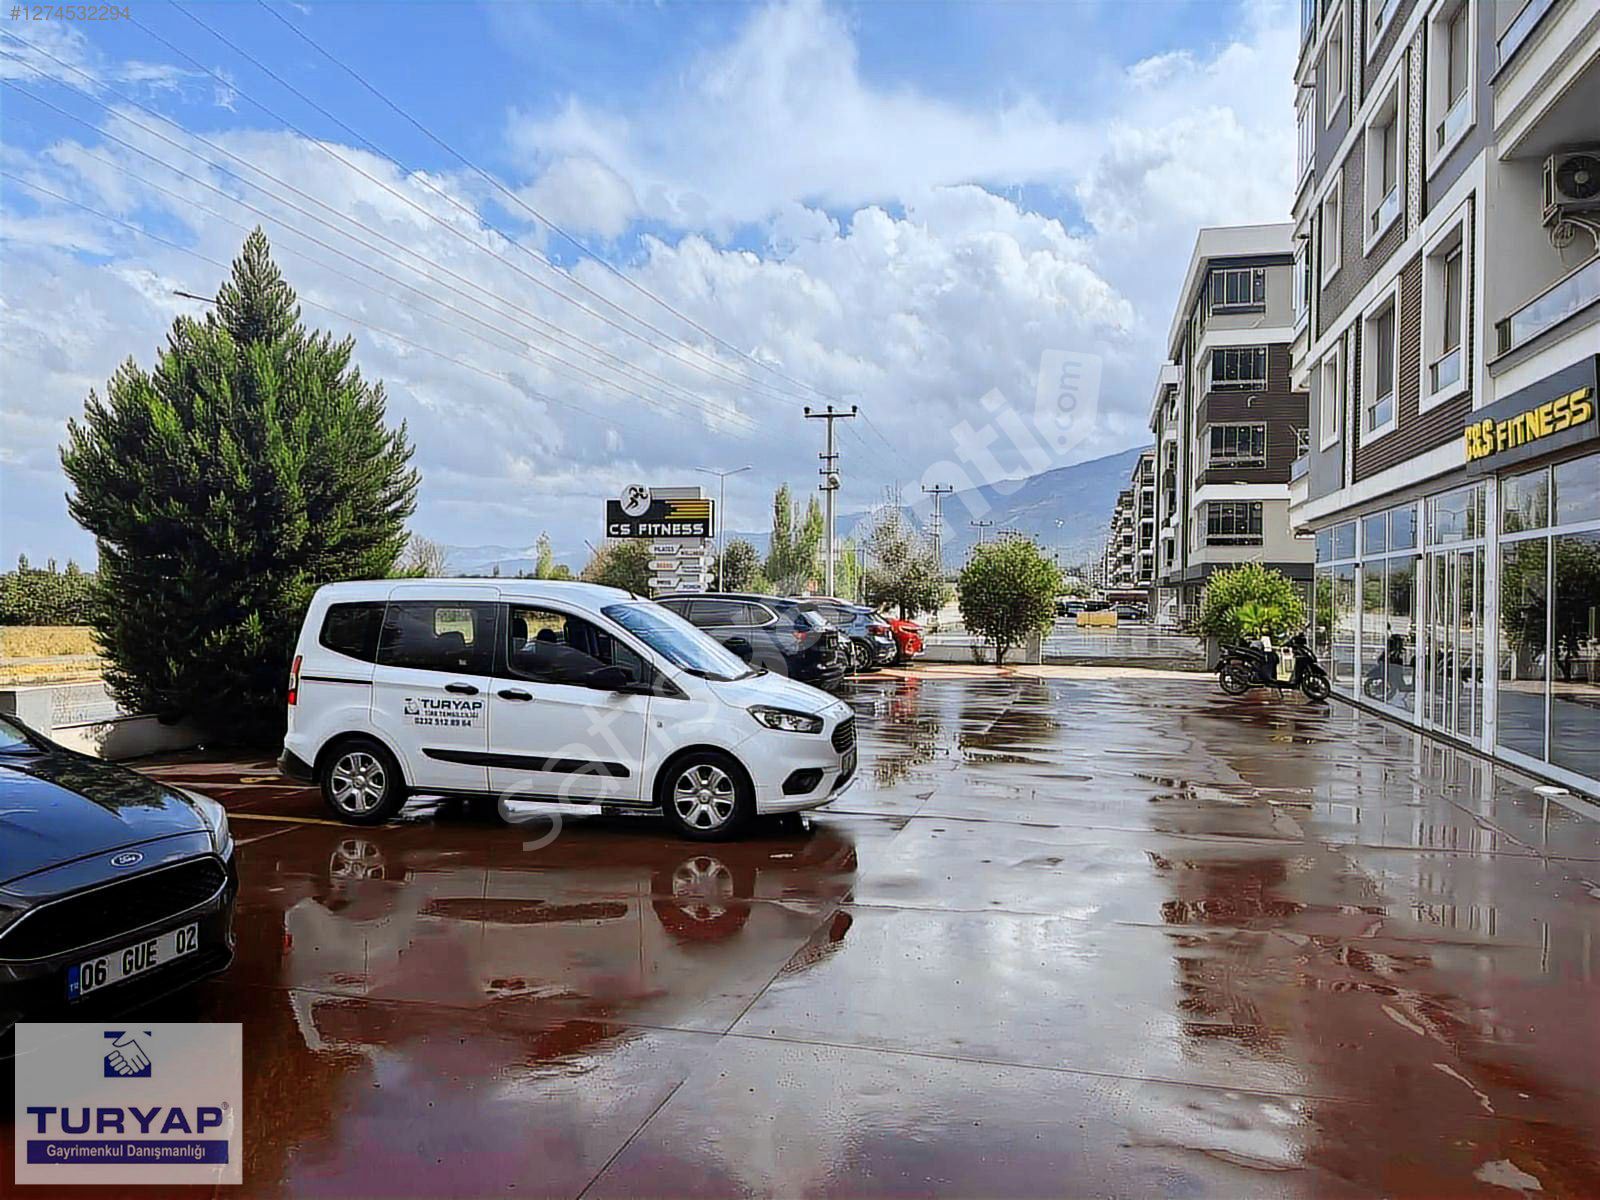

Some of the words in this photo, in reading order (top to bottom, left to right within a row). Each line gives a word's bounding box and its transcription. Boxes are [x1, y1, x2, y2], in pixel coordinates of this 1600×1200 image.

[1496, 387, 1592, 452] FITNESS
[609, 523, 631, 535] CS
[639, 523, 704, 535] FITNESS
[421, 699, 482, 710] TURYAP
[69, 982, 80, 993] TR
[81, 959, 108, 990] 06
[122, 939, 157, 976] GUE
[176, 925, 196, 954] 02
